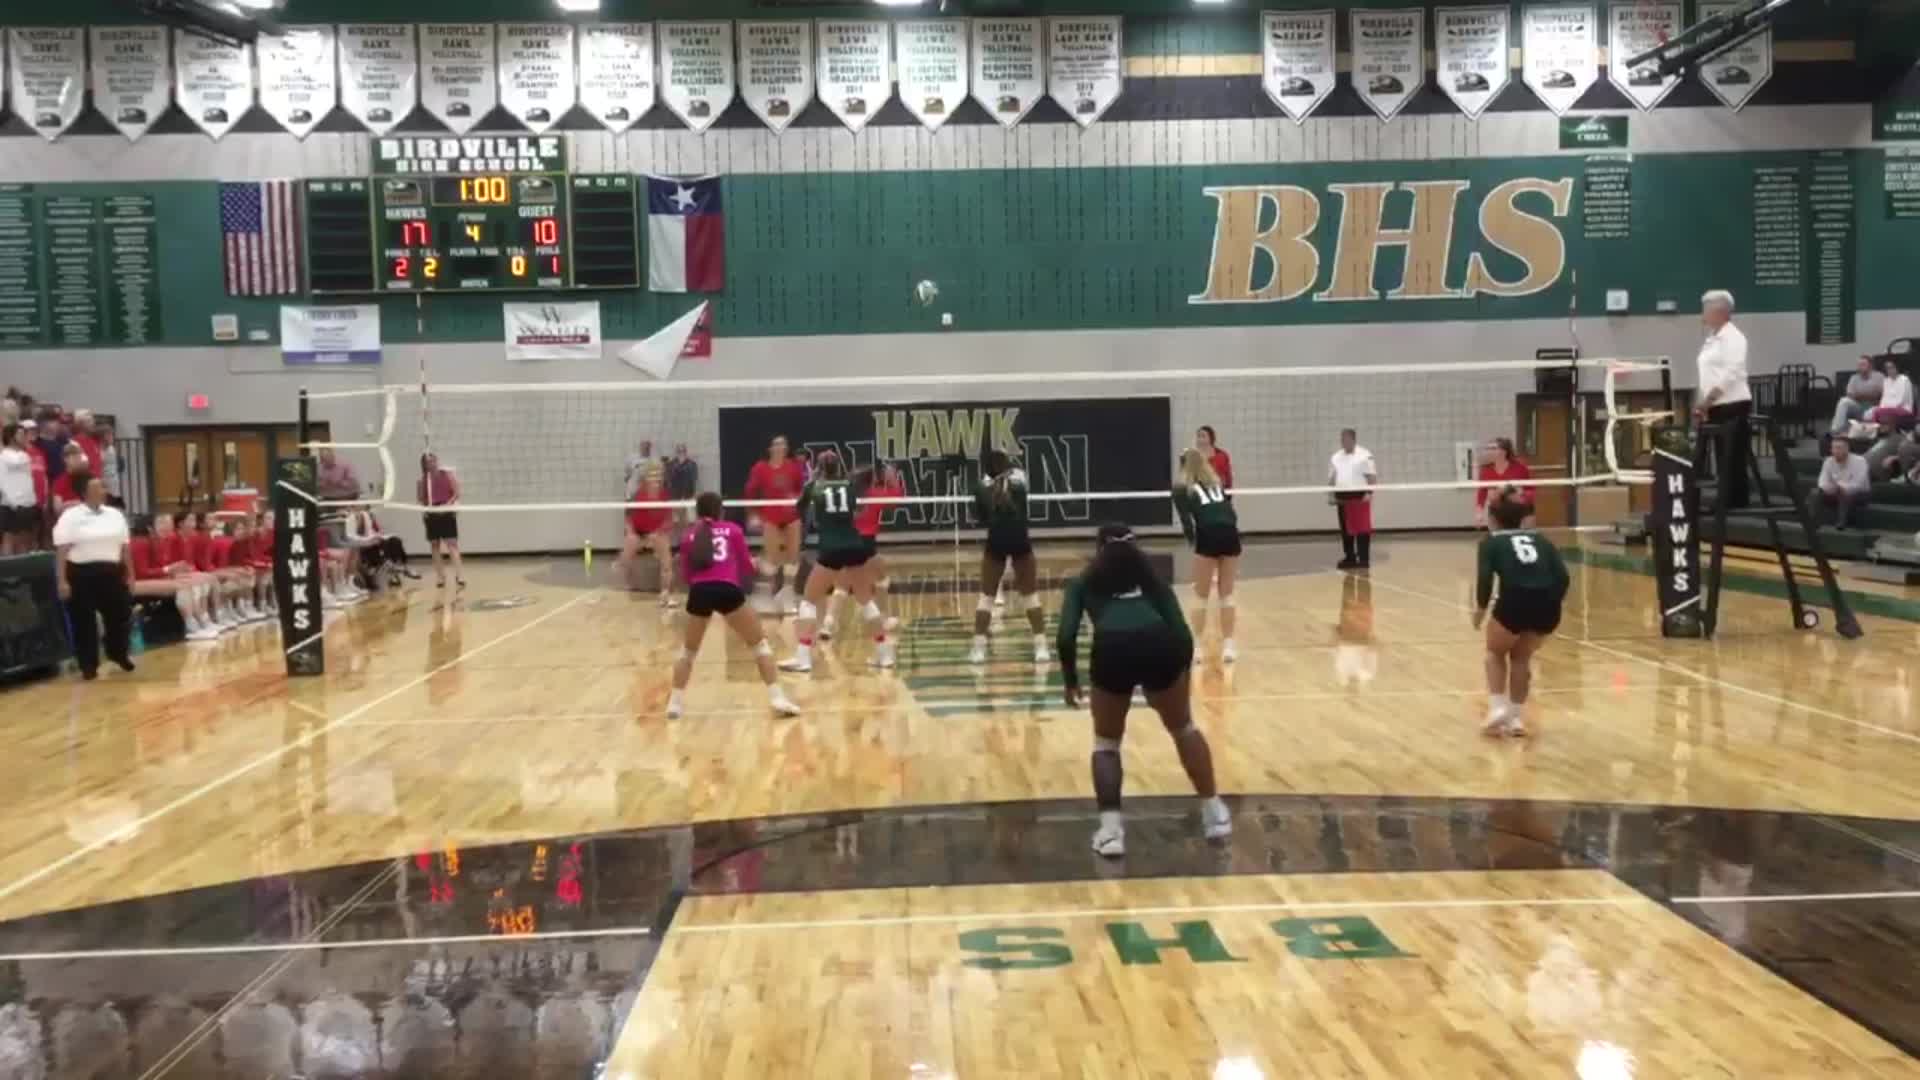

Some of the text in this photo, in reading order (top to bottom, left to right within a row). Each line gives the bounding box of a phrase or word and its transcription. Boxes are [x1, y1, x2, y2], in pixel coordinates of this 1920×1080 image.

[442, 39, 472, 48] HAWK
[522, 40, 550, 48] HAWK
[681, 37, 709, 45] HAWK
[760, 37, 789, 45] HAWK
[839, 35, 867, 44] HAWK
[993, 34, 1021, 42] HAWK
[1055, 33, 1113, 43] LADY HAWK
[380, 137, 558, 160] BIRDVILLE
[396, 157, 544, 172] HIGH SCHOOL
[460, 177, 506, 202] 1:00
[385, 207, 427, 220] HAWKS
[518, 205, 555, 218] GUEST
[403, 221, 427, 245] 17
[464, 223, 481, 243] 4
[533, 219, 557, 244] 10
[1187, 177, 1575, 305] BHS
[395, 257, 409, 278] 2
[423, 257, 438, 278] 2
[511, 255, 526, 276] 0
[552, 255, 558, 273] 1
[872, 407, 1023, 460] HAWK
[823, 486, 849, 513] 11
[1668, 473, 1690, 592] HAWKS
[712, 536, 728, 561] 3
[1510, 535, 1538, 563] 6
[288, 507, 311, 630] HAWKS
